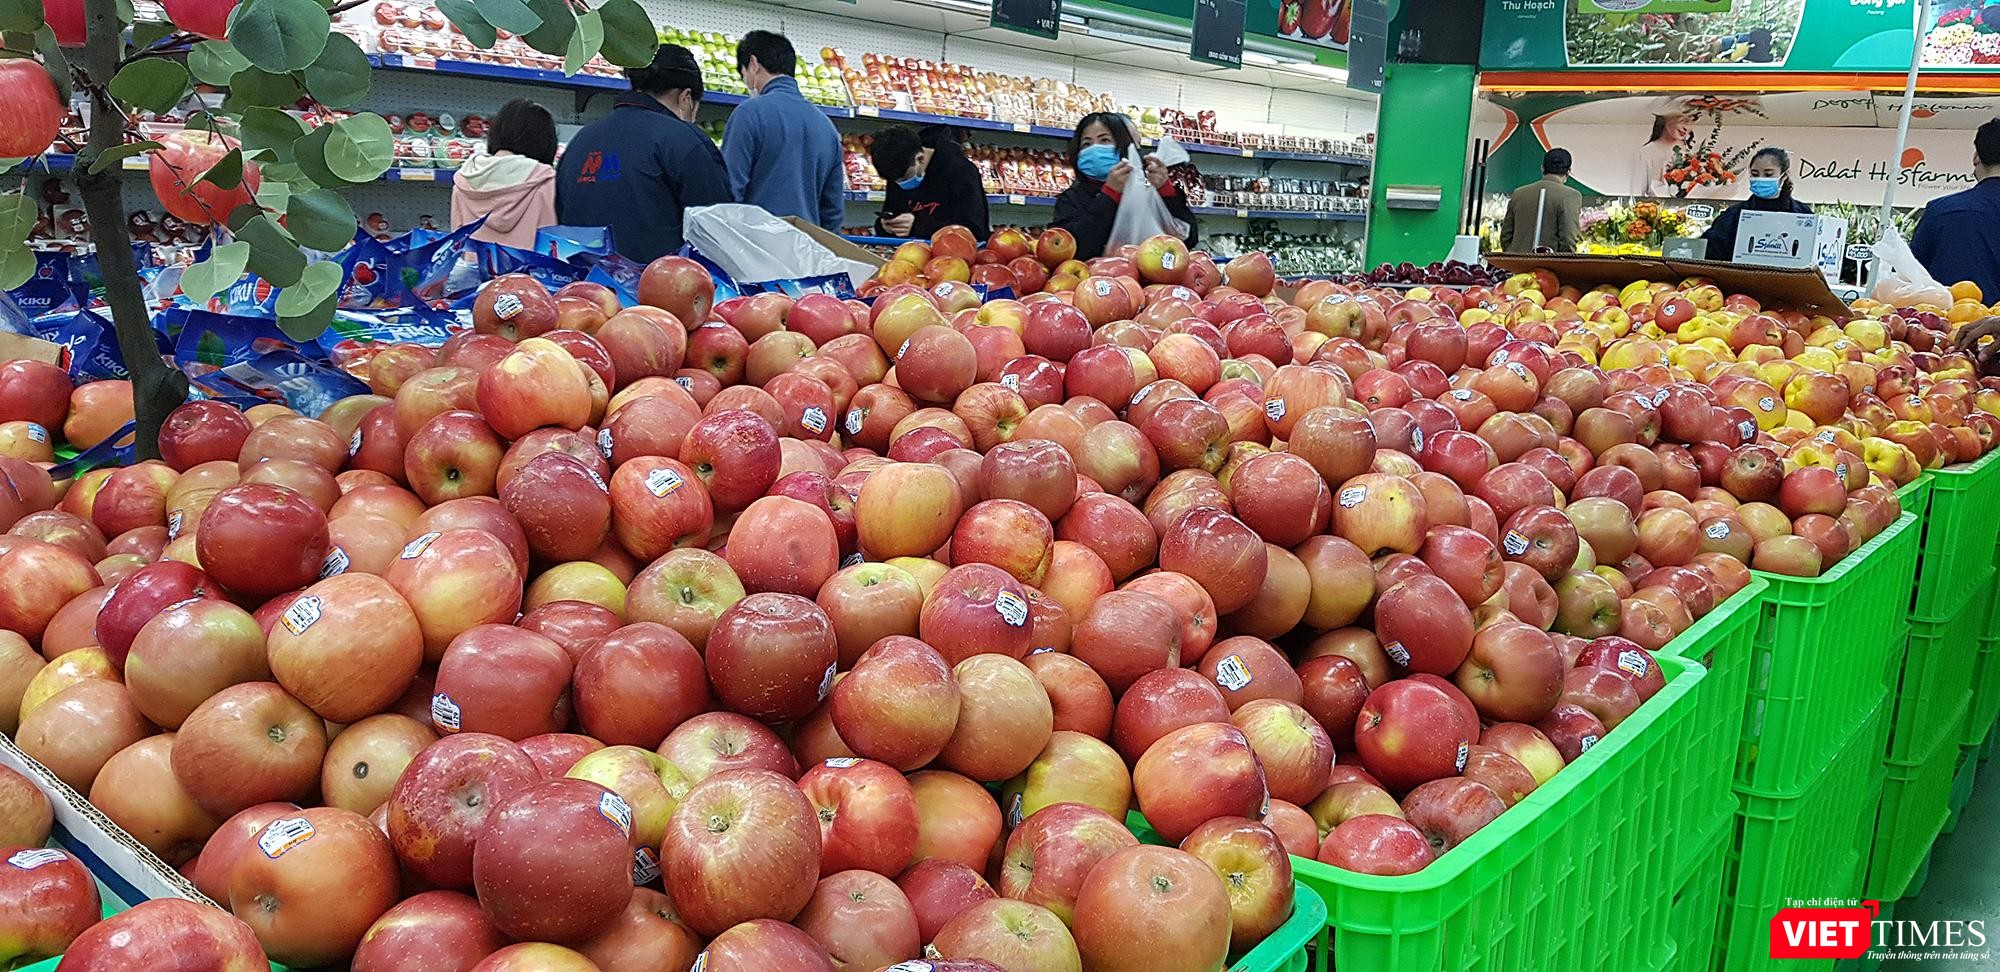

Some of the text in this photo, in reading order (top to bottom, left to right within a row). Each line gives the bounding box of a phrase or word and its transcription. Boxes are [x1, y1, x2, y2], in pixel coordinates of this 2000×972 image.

[1502, 0, 1555, 12] Thu Hoạch
[1041, 18, 1055, 30] VAT
[1799, 158, 1976, 187] Dalat Hsfarm
[18, 297, 52, 306] KIKU
[95, 352, 130, 377] KIKU
